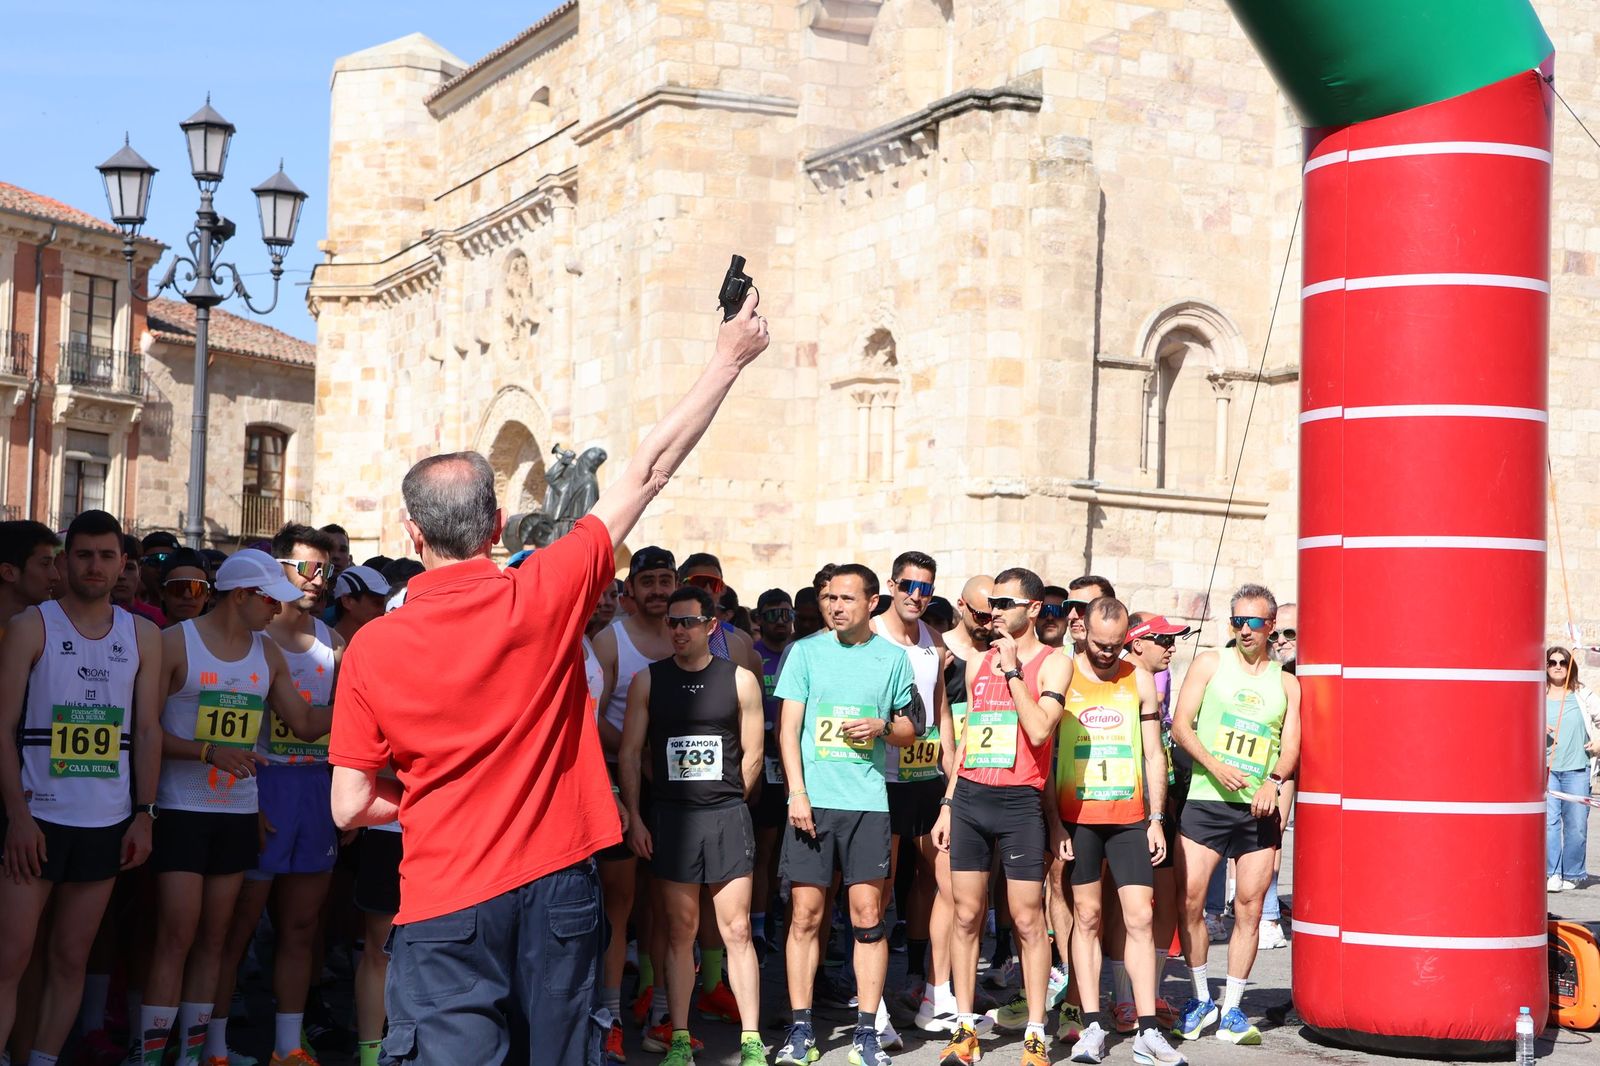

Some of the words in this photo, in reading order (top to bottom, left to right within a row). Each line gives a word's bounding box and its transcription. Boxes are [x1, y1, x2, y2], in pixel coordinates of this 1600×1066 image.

[207, 710, 249, 738] 161
[1083, 709, 1121, 724] Serrano
[57, 726, 110, 755] 169
[671, 740, 684, 748] 10K
[685, 740, 719, 748] ZAMORA
[980, 727, 993, 748] 2
[1225, 731, 1257, 757] 111
[287, 747, 304, 755] CAJA
[305, 748, 325, 756] RURAL
[675, 750, 715, 766] 733
[848, 752, 870, 760] RURAL
[903, 742, 935, 764] 349
[69, 764, 89, 772] CAJA
[92, 765, 116, 773] RURAL
[1097, 759, 1108, 782] 1
[1224, 758, 1241, 768] CAJA
[1240, 763, 1262, 773] RURAL
